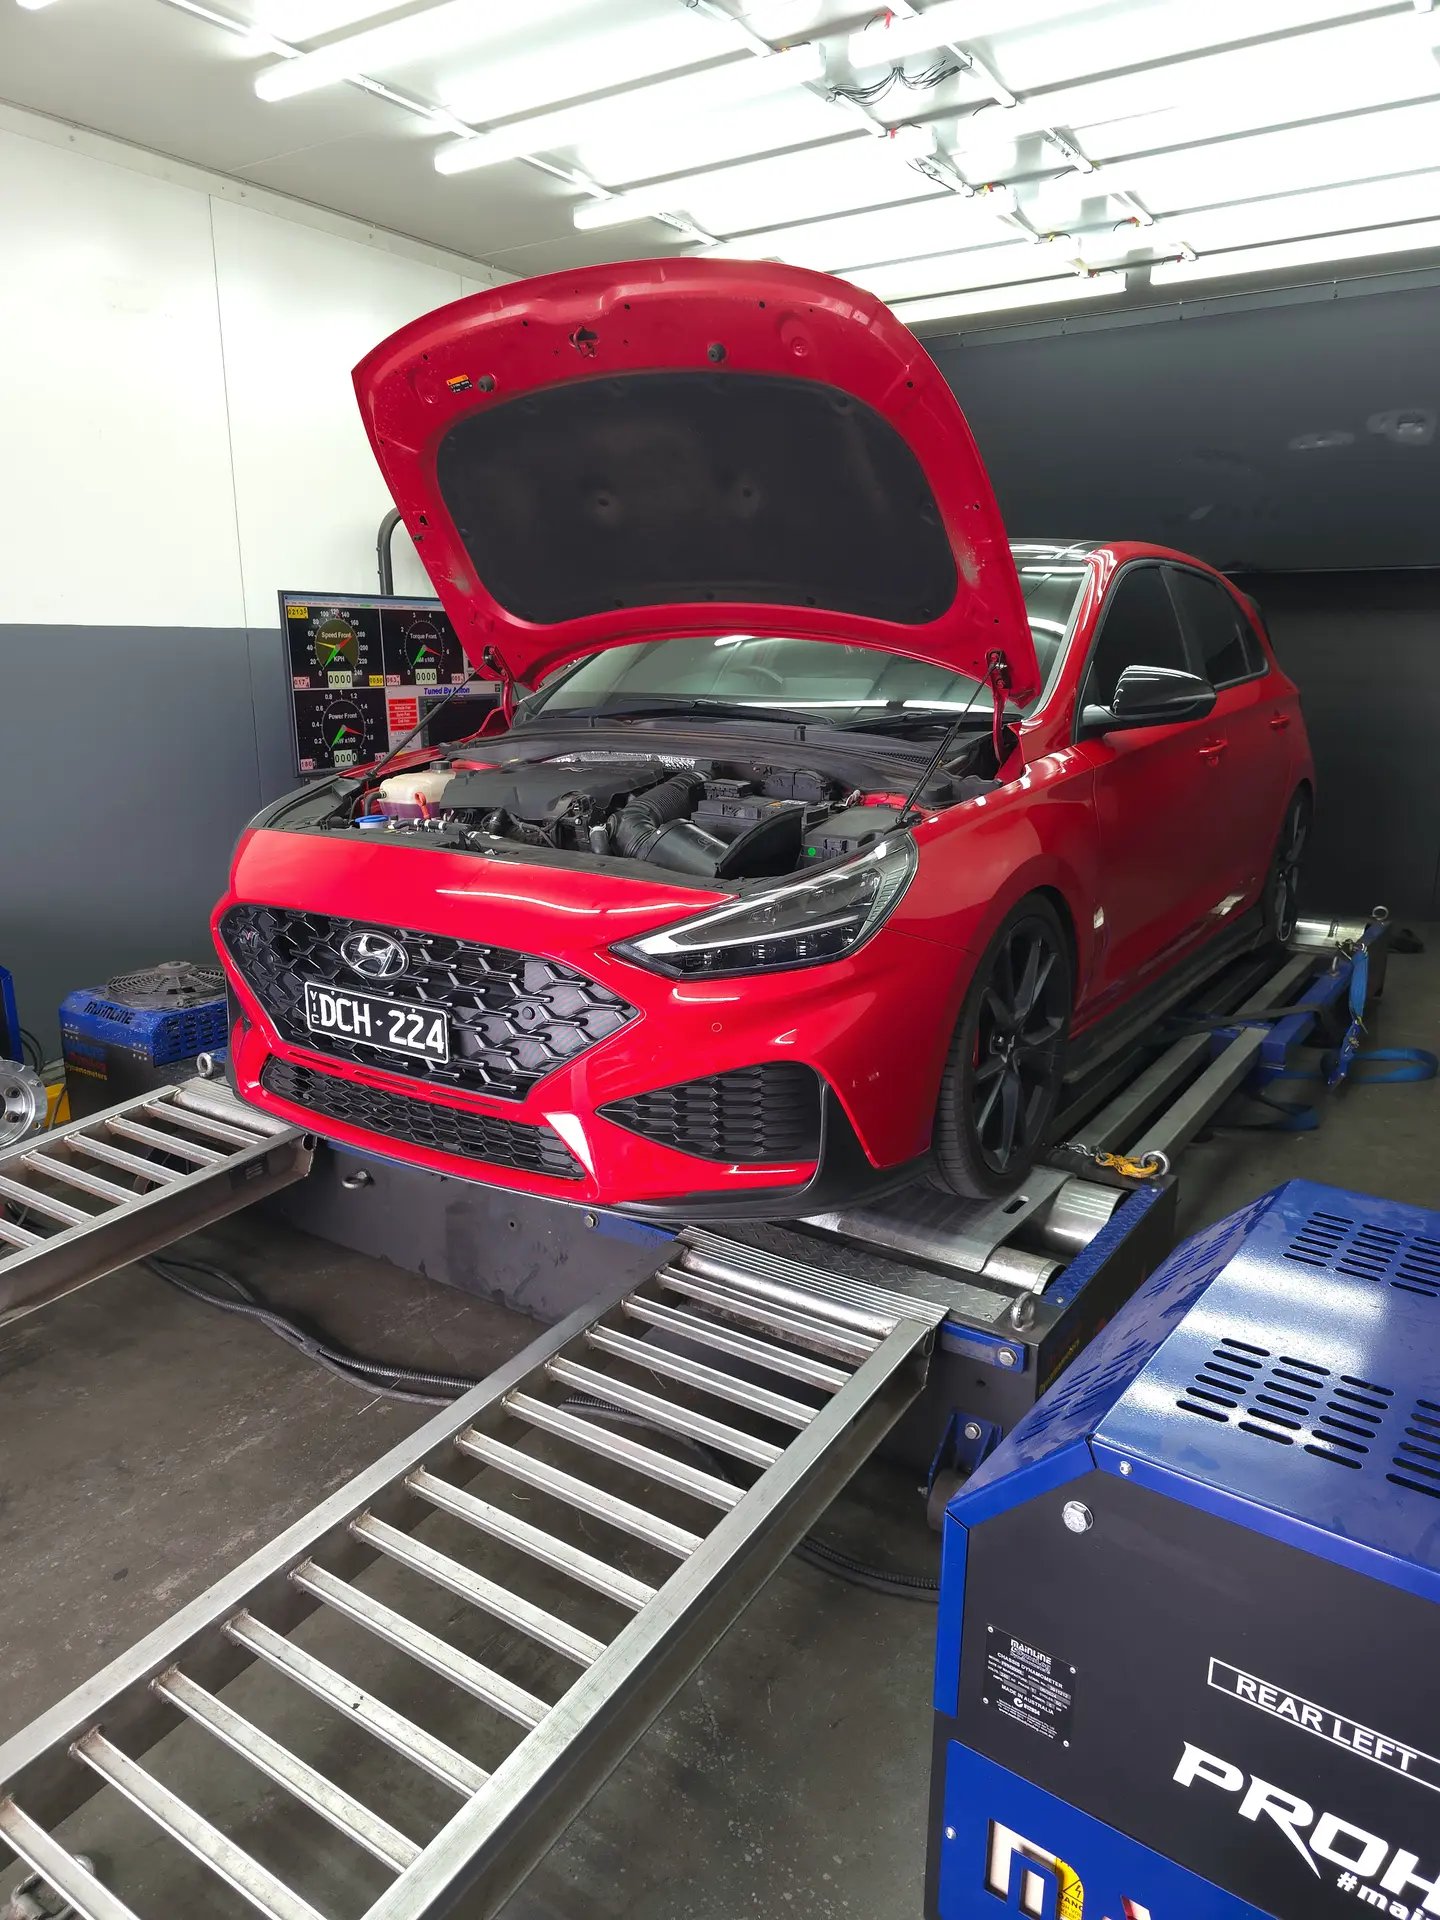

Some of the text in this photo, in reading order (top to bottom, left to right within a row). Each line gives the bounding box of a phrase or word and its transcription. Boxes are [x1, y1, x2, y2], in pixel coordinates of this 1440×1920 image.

[329, 675, 351, 684] 0000
[416, 672, 436, 680] 0000
[424, 687, 442, 695] Tuned
[444, 687, 452, 695] By
[335, 753, 357, 762] 0000
[319, 993, 445, 1054] DCH 224
[997, 1652, 1020, 1667] CHASSIS
[1021, 1665, 1063, 1689] DYNAMOMETER
[1002, 1685, 1016, 1696] MADE
[1024, 1697, 1054, 1715] AUSTRALIA
[1236, 1674, 1417, 1772] REAR LEFT
